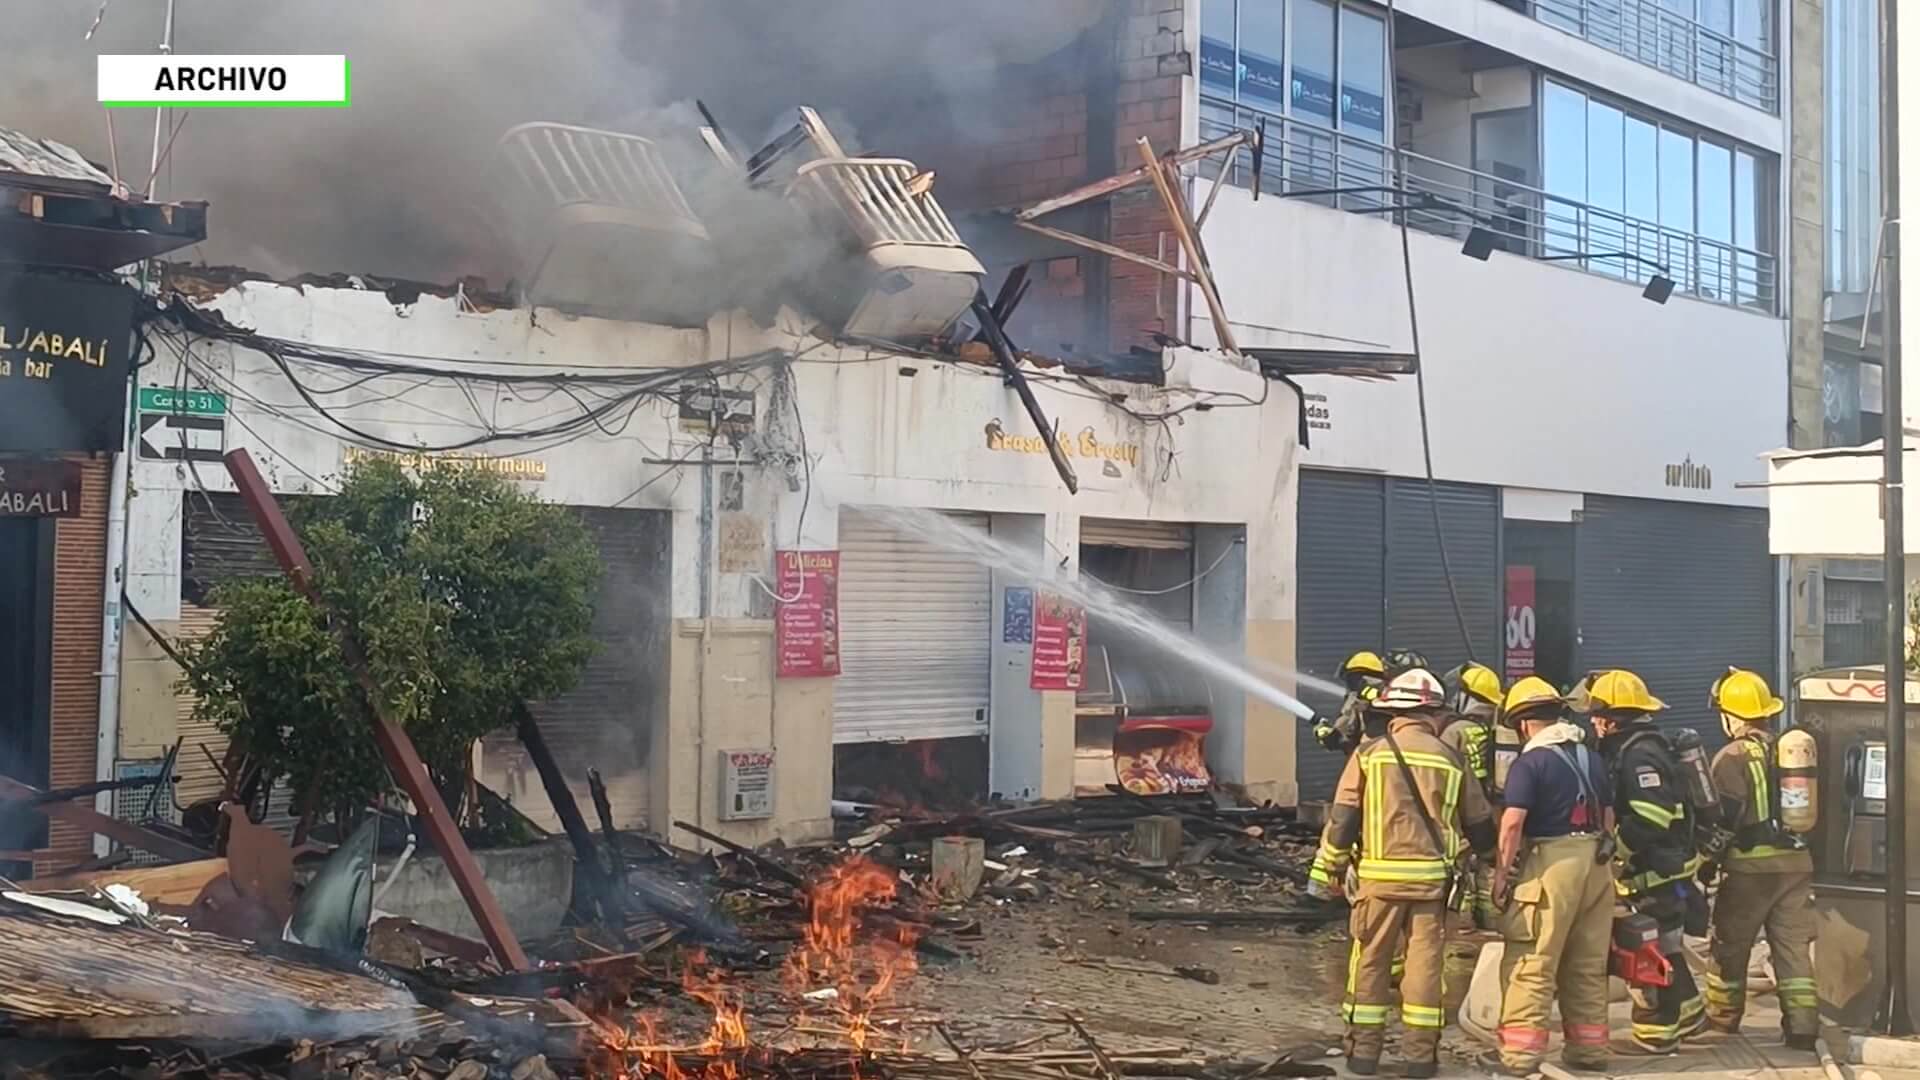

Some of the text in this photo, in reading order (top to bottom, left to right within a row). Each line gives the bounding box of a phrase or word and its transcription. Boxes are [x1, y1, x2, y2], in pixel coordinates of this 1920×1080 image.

[16, 327, 108, 367] JABALÍ
[25, 357, 53, 379] bar
[198, 397, 213, 409] 51
[1305, 404, 1329, 420] das
[0, 490, 68, 513] ABALI
[784, 552, 833, 569] Dlicias
